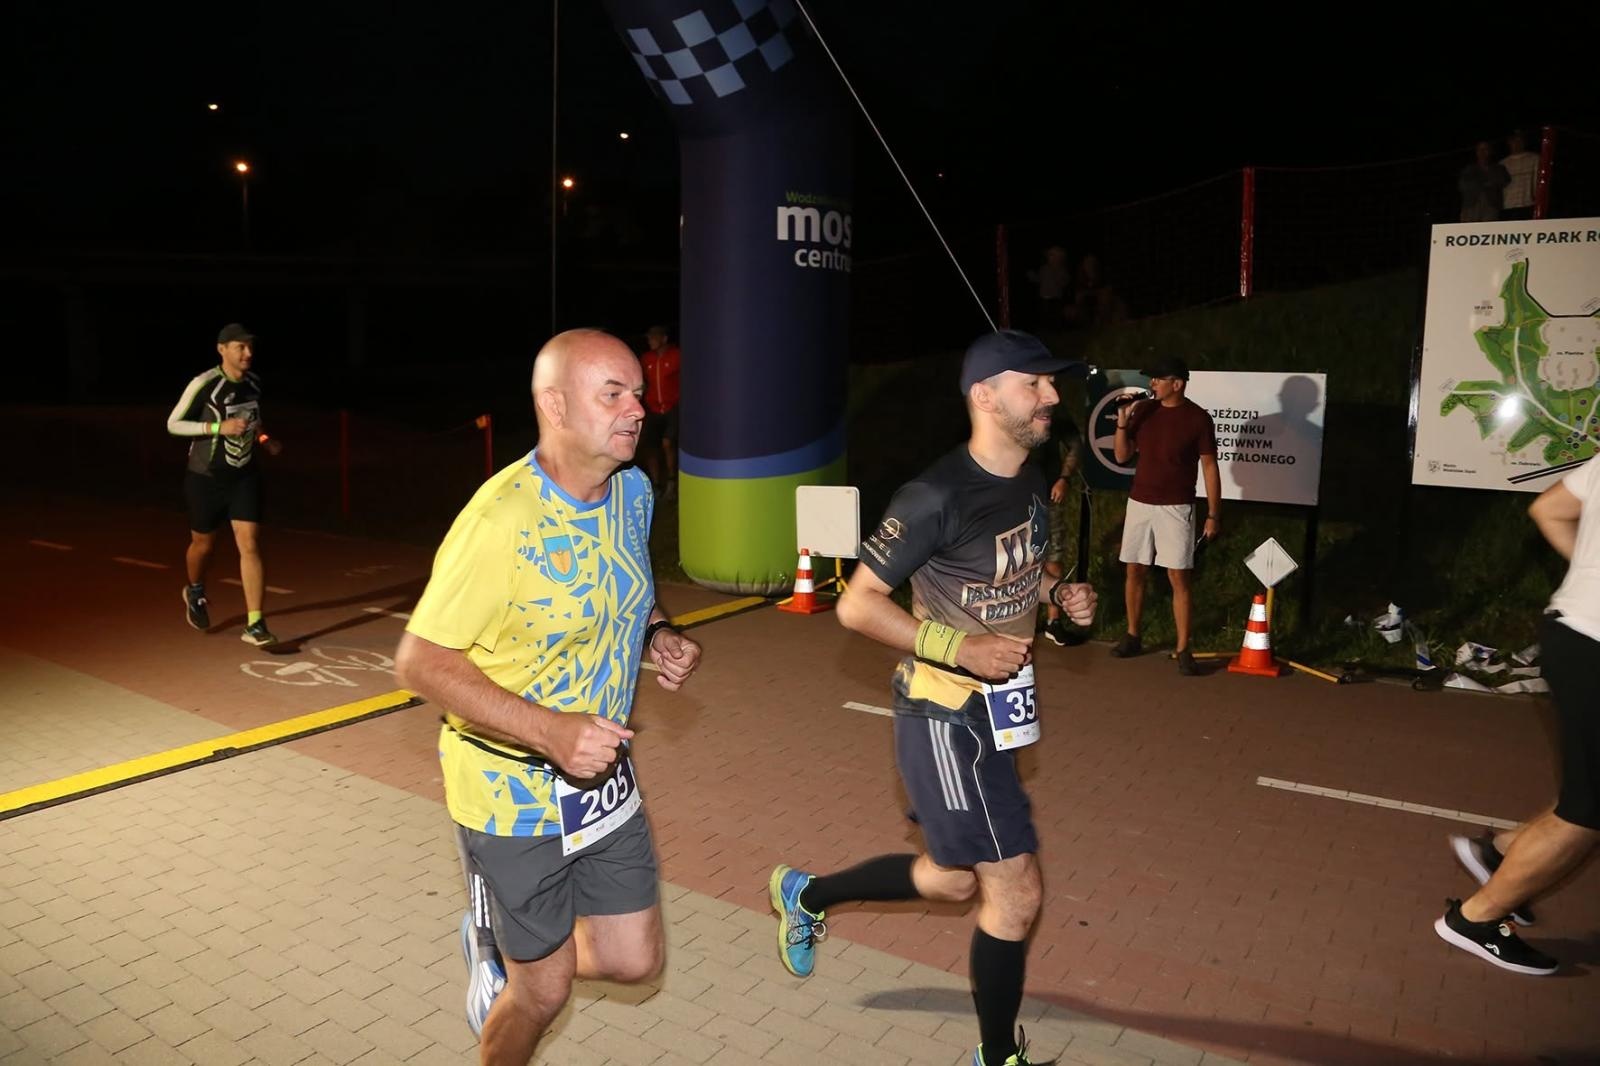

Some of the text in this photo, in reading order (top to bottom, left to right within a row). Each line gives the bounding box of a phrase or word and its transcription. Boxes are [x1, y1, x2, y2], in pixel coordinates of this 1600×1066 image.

[1445, 232, 1533, 247] RODZINNY
[1536, 230, 1582, 244] PARK
[1211, 407, 1259, 420] JEŹDZIJ
[1214, 423, 1266, 435] IERUNKU
[1216, 437, 1273, 450] ECIWNYM
[1006, 688, 1035, 723] 35
[580, 763, 628, 826] 205
